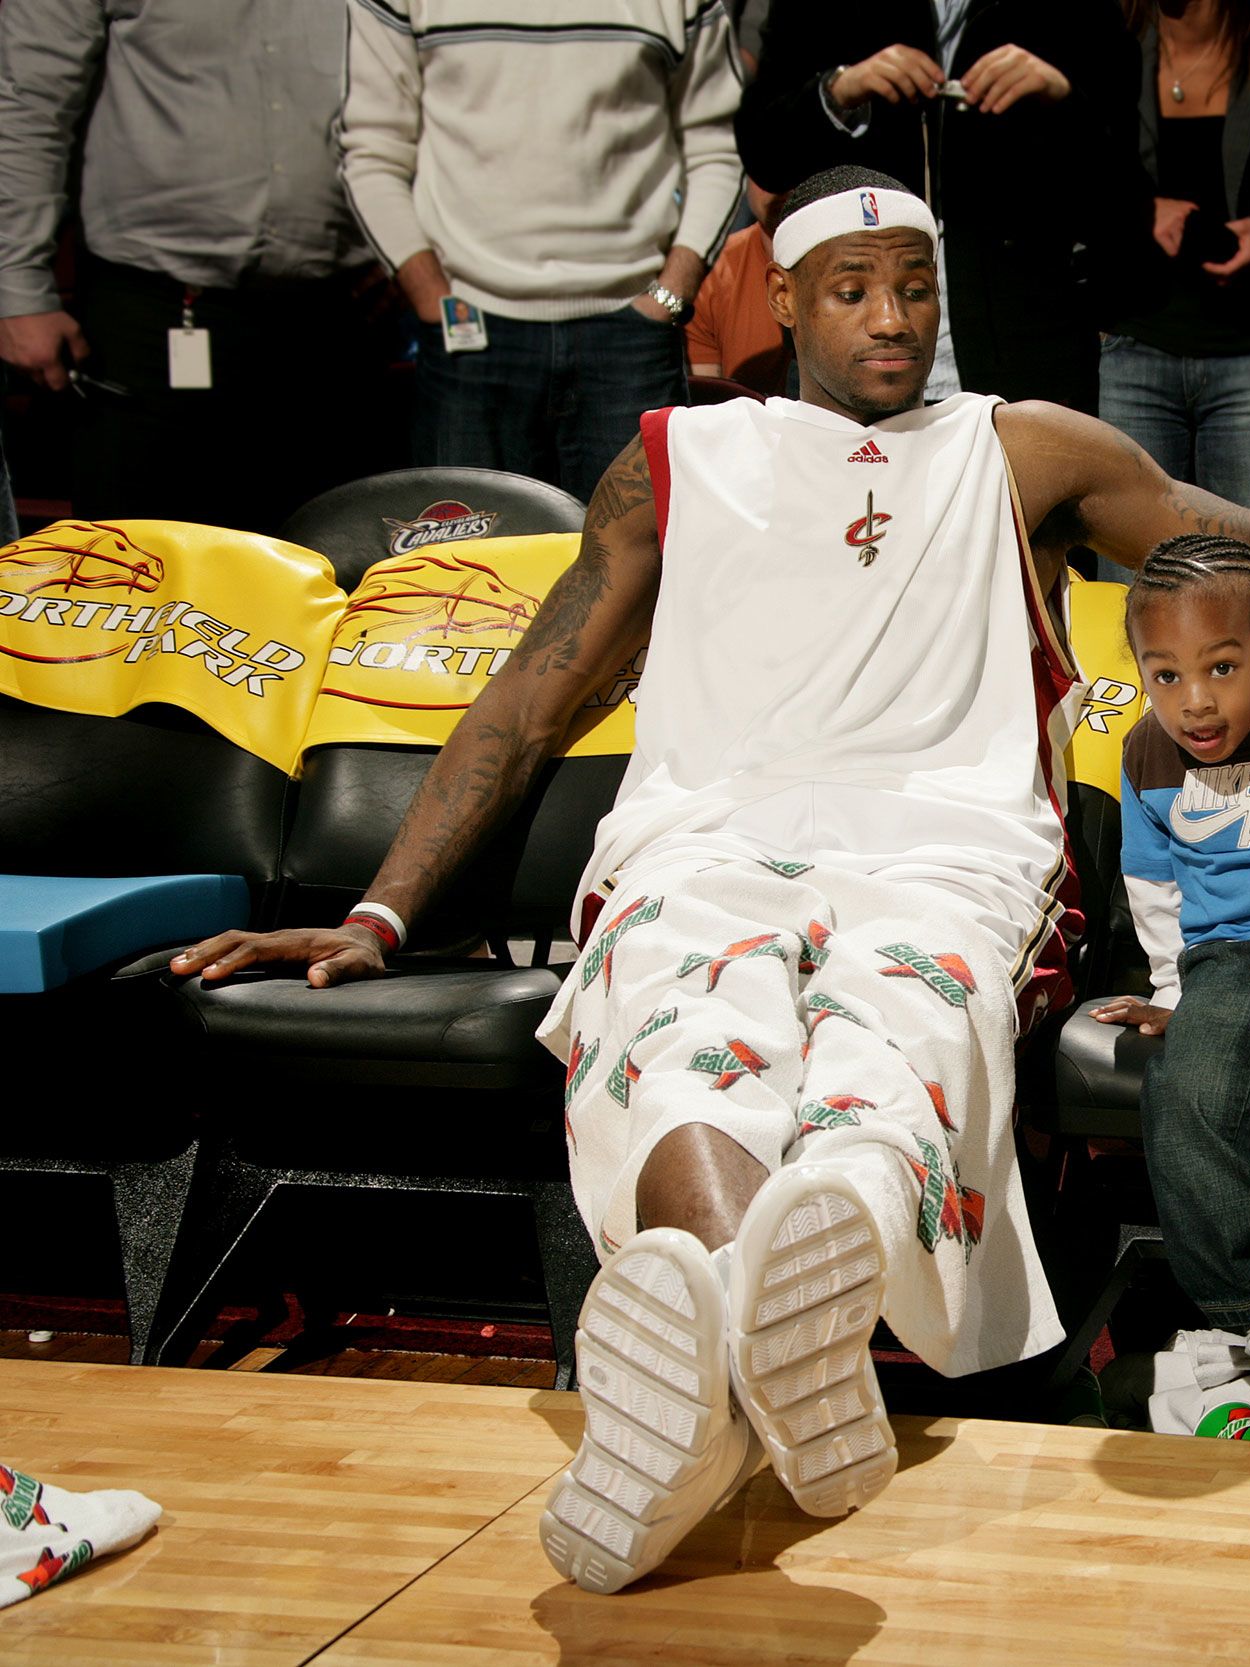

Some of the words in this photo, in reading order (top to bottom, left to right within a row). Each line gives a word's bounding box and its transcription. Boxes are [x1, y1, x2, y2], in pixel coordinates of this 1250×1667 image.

[847, 455, 889, 464] adidas
[393, 518, 491, 555] CAVALIERS
[0, 590, 306, 672] ORTHFIELD
[123, 628, 285, 697] PARK
